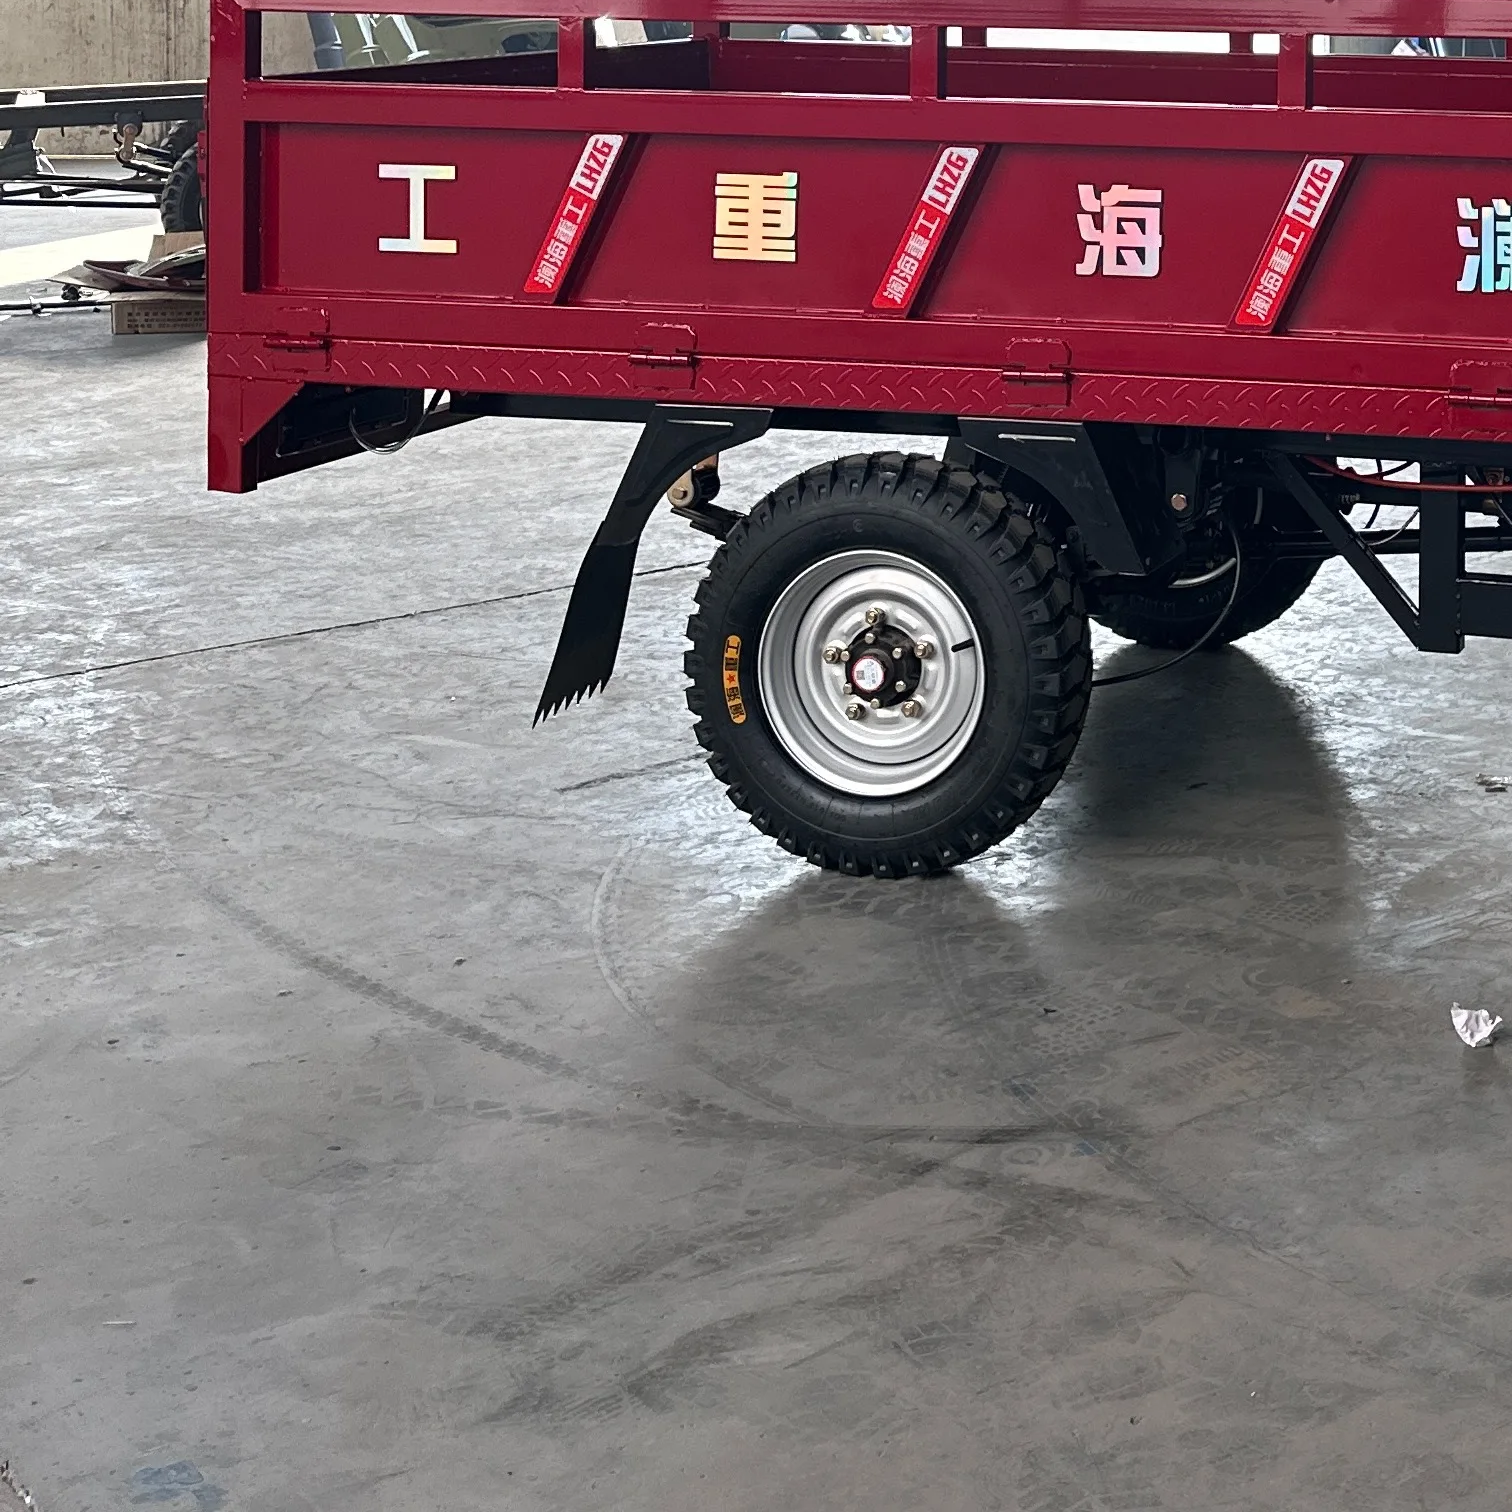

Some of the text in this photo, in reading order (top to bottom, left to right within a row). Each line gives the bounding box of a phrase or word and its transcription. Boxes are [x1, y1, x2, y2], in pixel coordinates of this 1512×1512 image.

[575, 138, 614, 194] LHZG
[927, 151, 969, 209] LHZG
[1291, 163, 1335, 223] LHZG
[533, 195, 588, 289] 澜海重工
[882, 209, 941, 305] 澜海重工
[1245, 223, 1305, 321] 澜海重工
